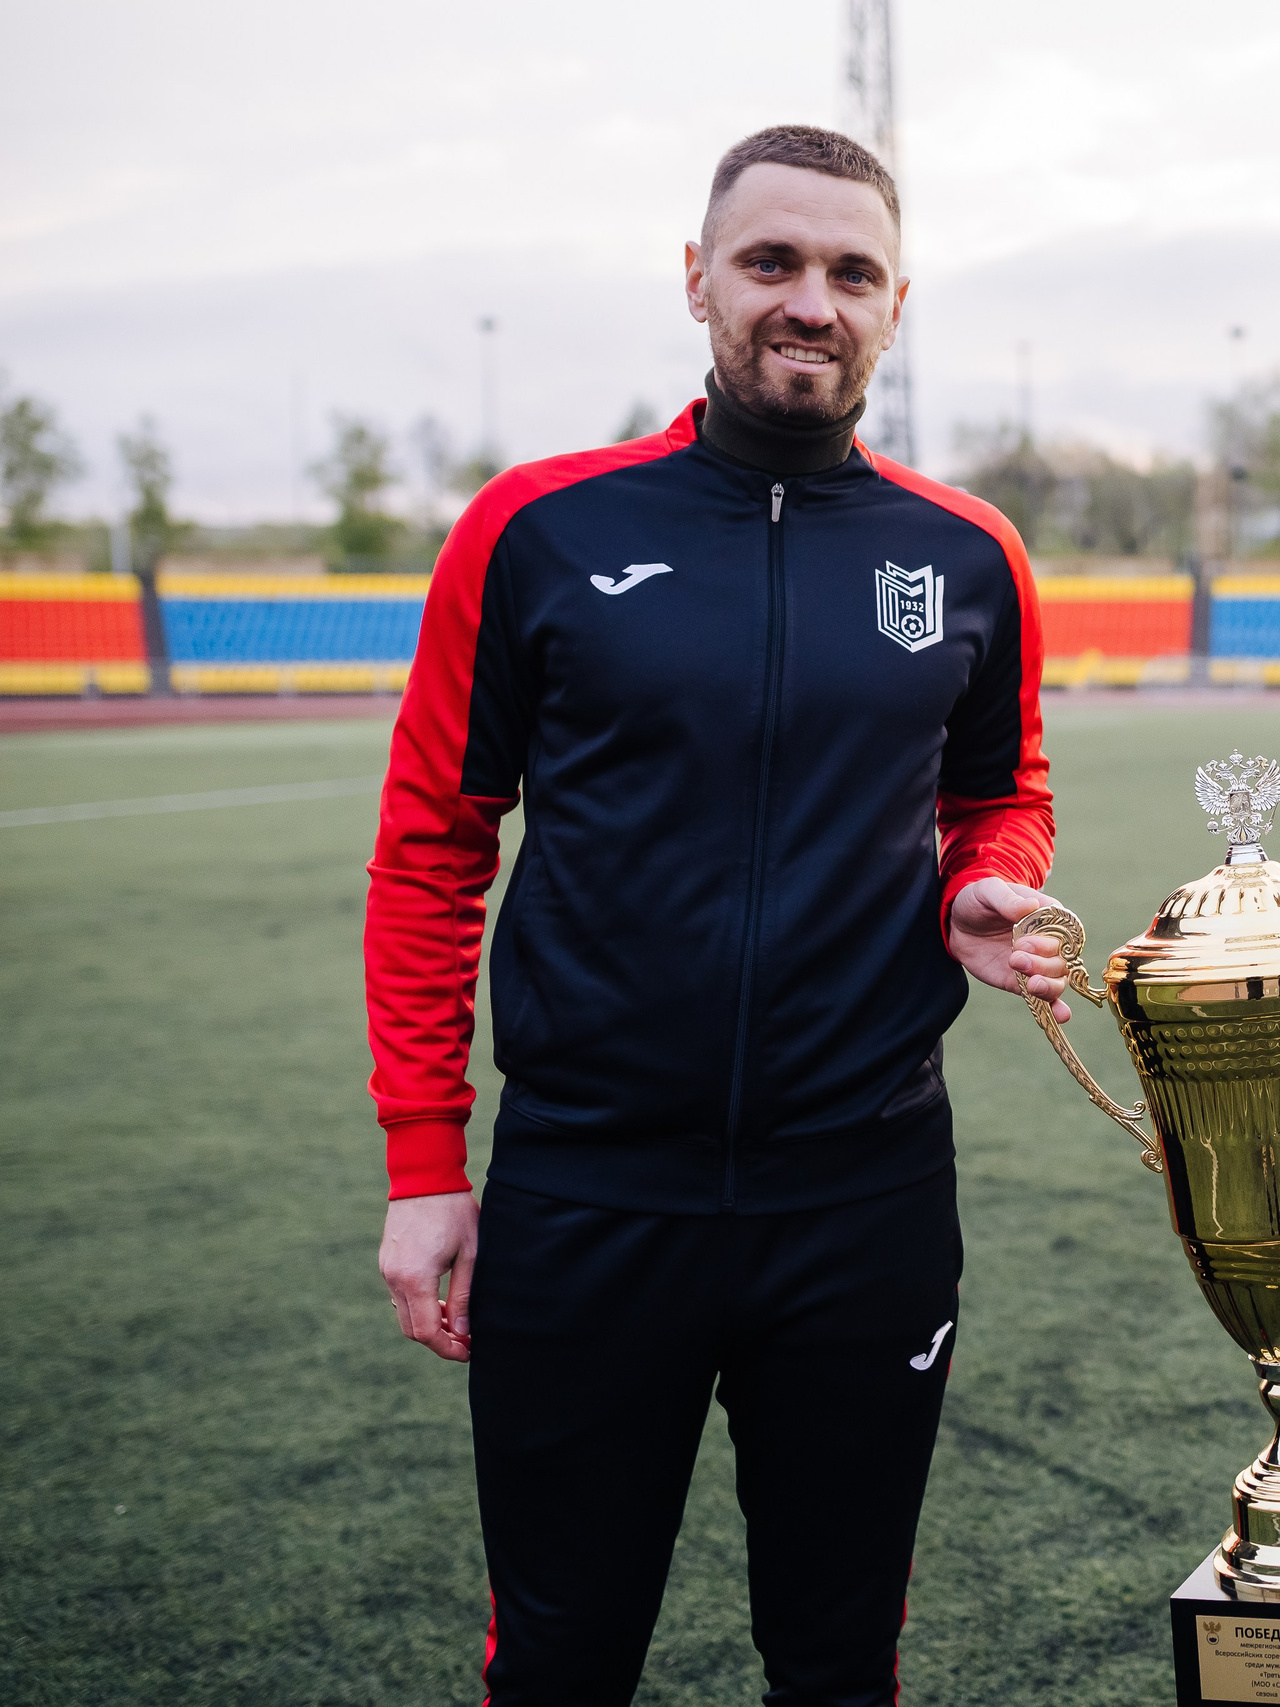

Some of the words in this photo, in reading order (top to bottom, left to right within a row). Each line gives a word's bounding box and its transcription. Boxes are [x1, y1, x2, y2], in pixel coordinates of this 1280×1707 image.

[900, 600, 924, 613] 1932
[1215, 1650, 1263, 1659] Всероссийских
[1244, 1662, 1264, 1670] среди
[1251, 1680, 1271, 1688] (МОО
